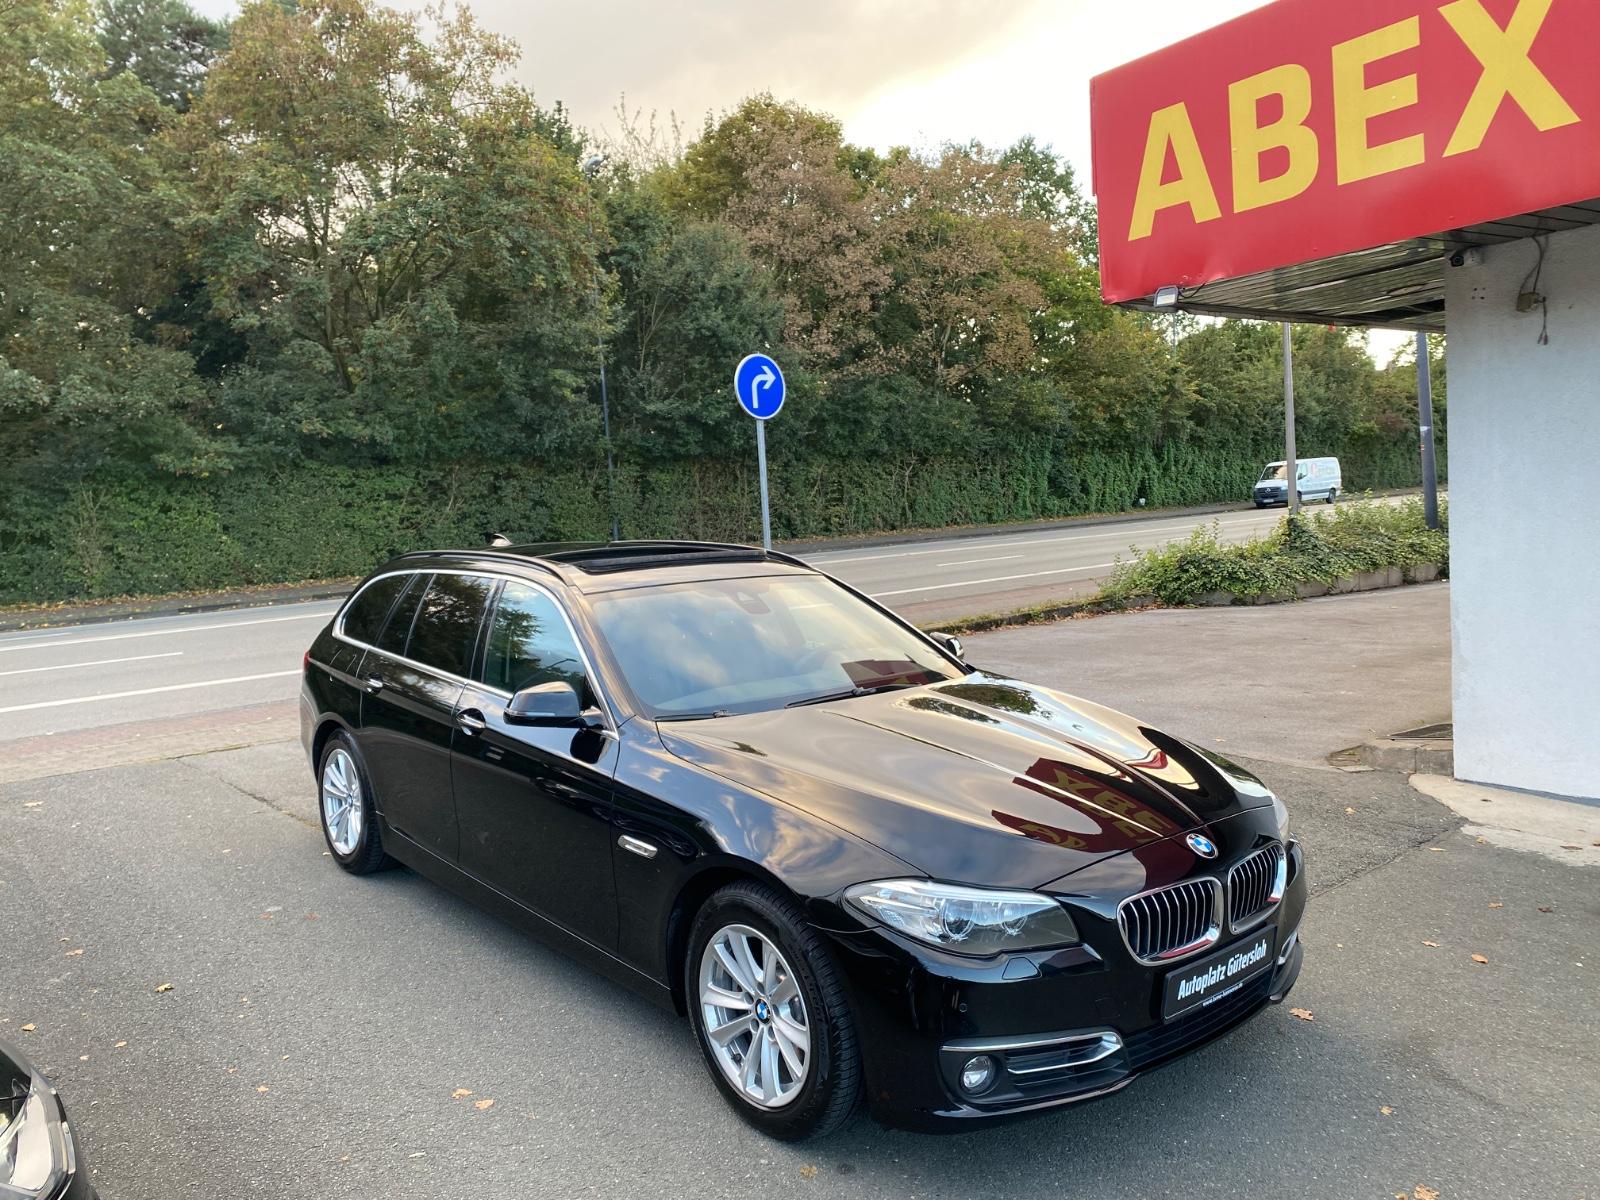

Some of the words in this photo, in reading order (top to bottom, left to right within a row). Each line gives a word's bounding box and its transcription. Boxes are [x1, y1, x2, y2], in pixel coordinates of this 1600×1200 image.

[1128, 0, 1581, 241] ABEX
[1177, 964, 1226, 1000] Autoplatz
[1227, 939, 1267, 977] Gütersloh
